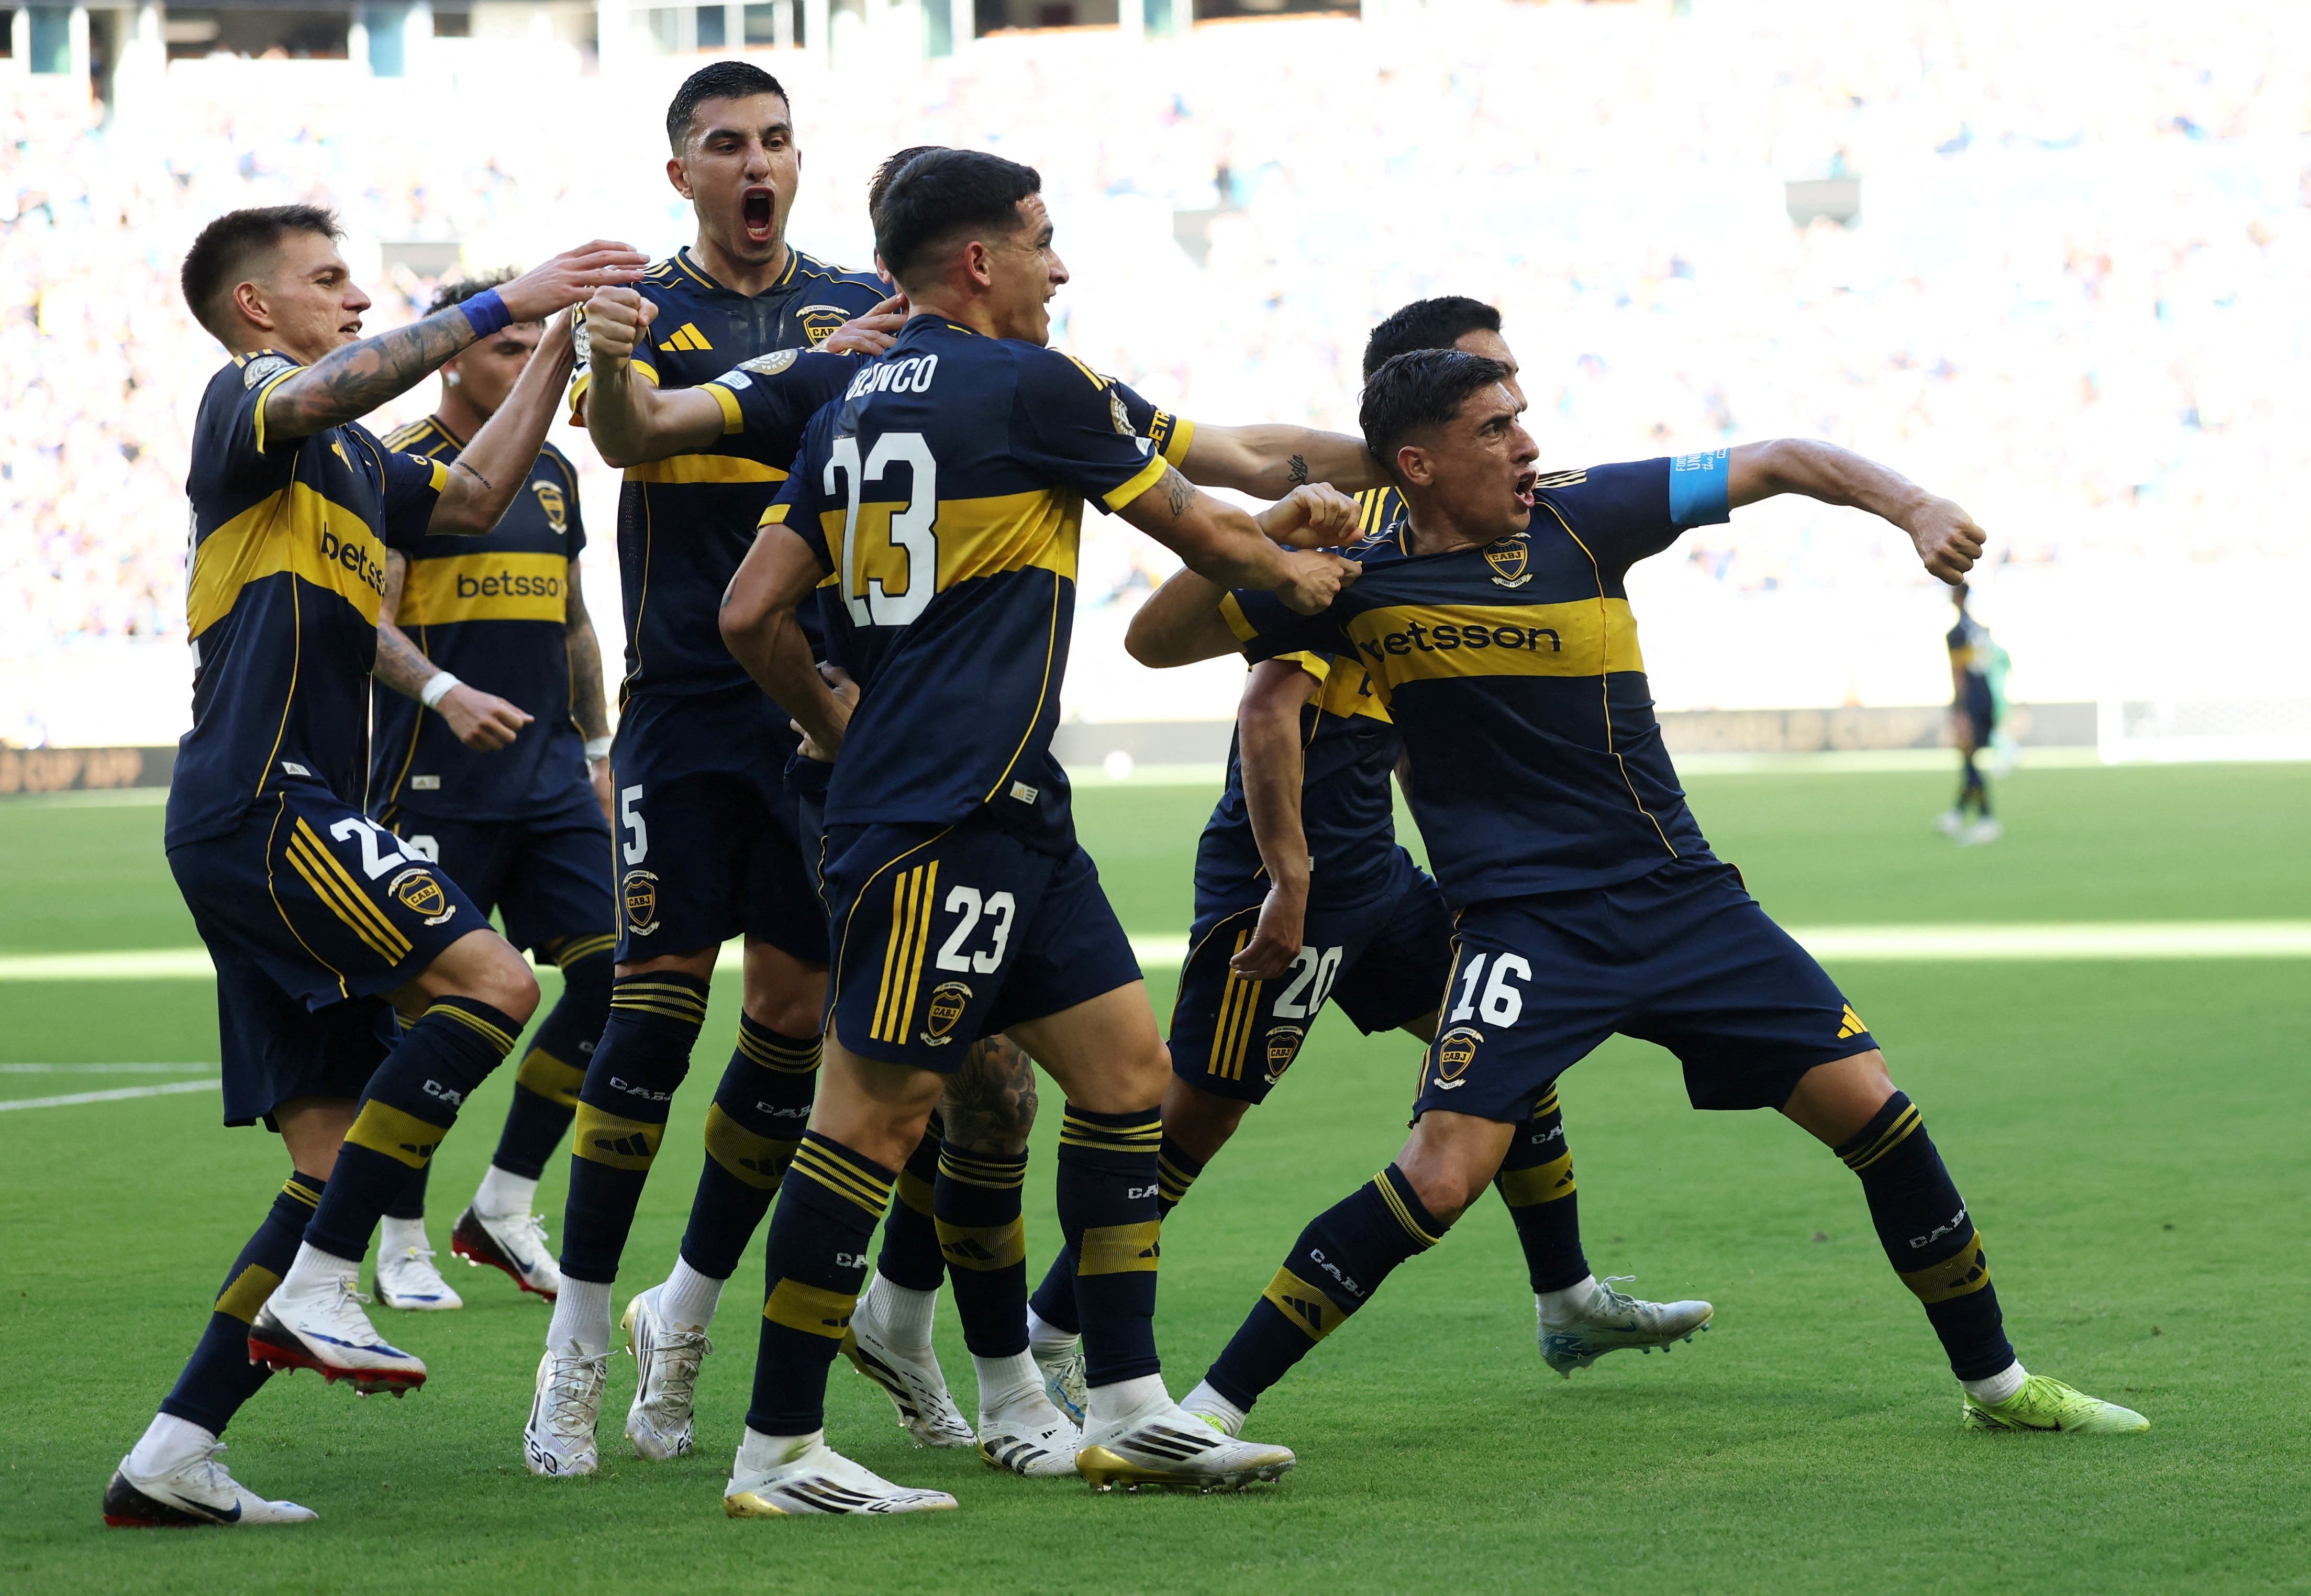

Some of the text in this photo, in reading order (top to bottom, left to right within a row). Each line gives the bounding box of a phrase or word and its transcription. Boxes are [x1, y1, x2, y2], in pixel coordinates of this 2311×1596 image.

[845, 354, 938, 401] BLANCO
[1492, 551, 1521, 561] CABJ
[621, 784, 648, 866] 5
[410, 887, 436, 904] CABJ
[629, 896, 651, 906] CABJ
[936, 885, 1016, 974] 23
[1272, 946, 1343, 1018] 20
[1449, 952, 1532, 1028] 16
[933, 1007, 957, 1017] CABJ
[1443, 1052, 1468, 1061] CABJ
[422, 1079, 466, 1107] CA
[1532, 1121, 1563, 1145] CA
[1128, 1182, 1159, 1199] CA
[1310, 1248, 1366, 1297] CABJ
